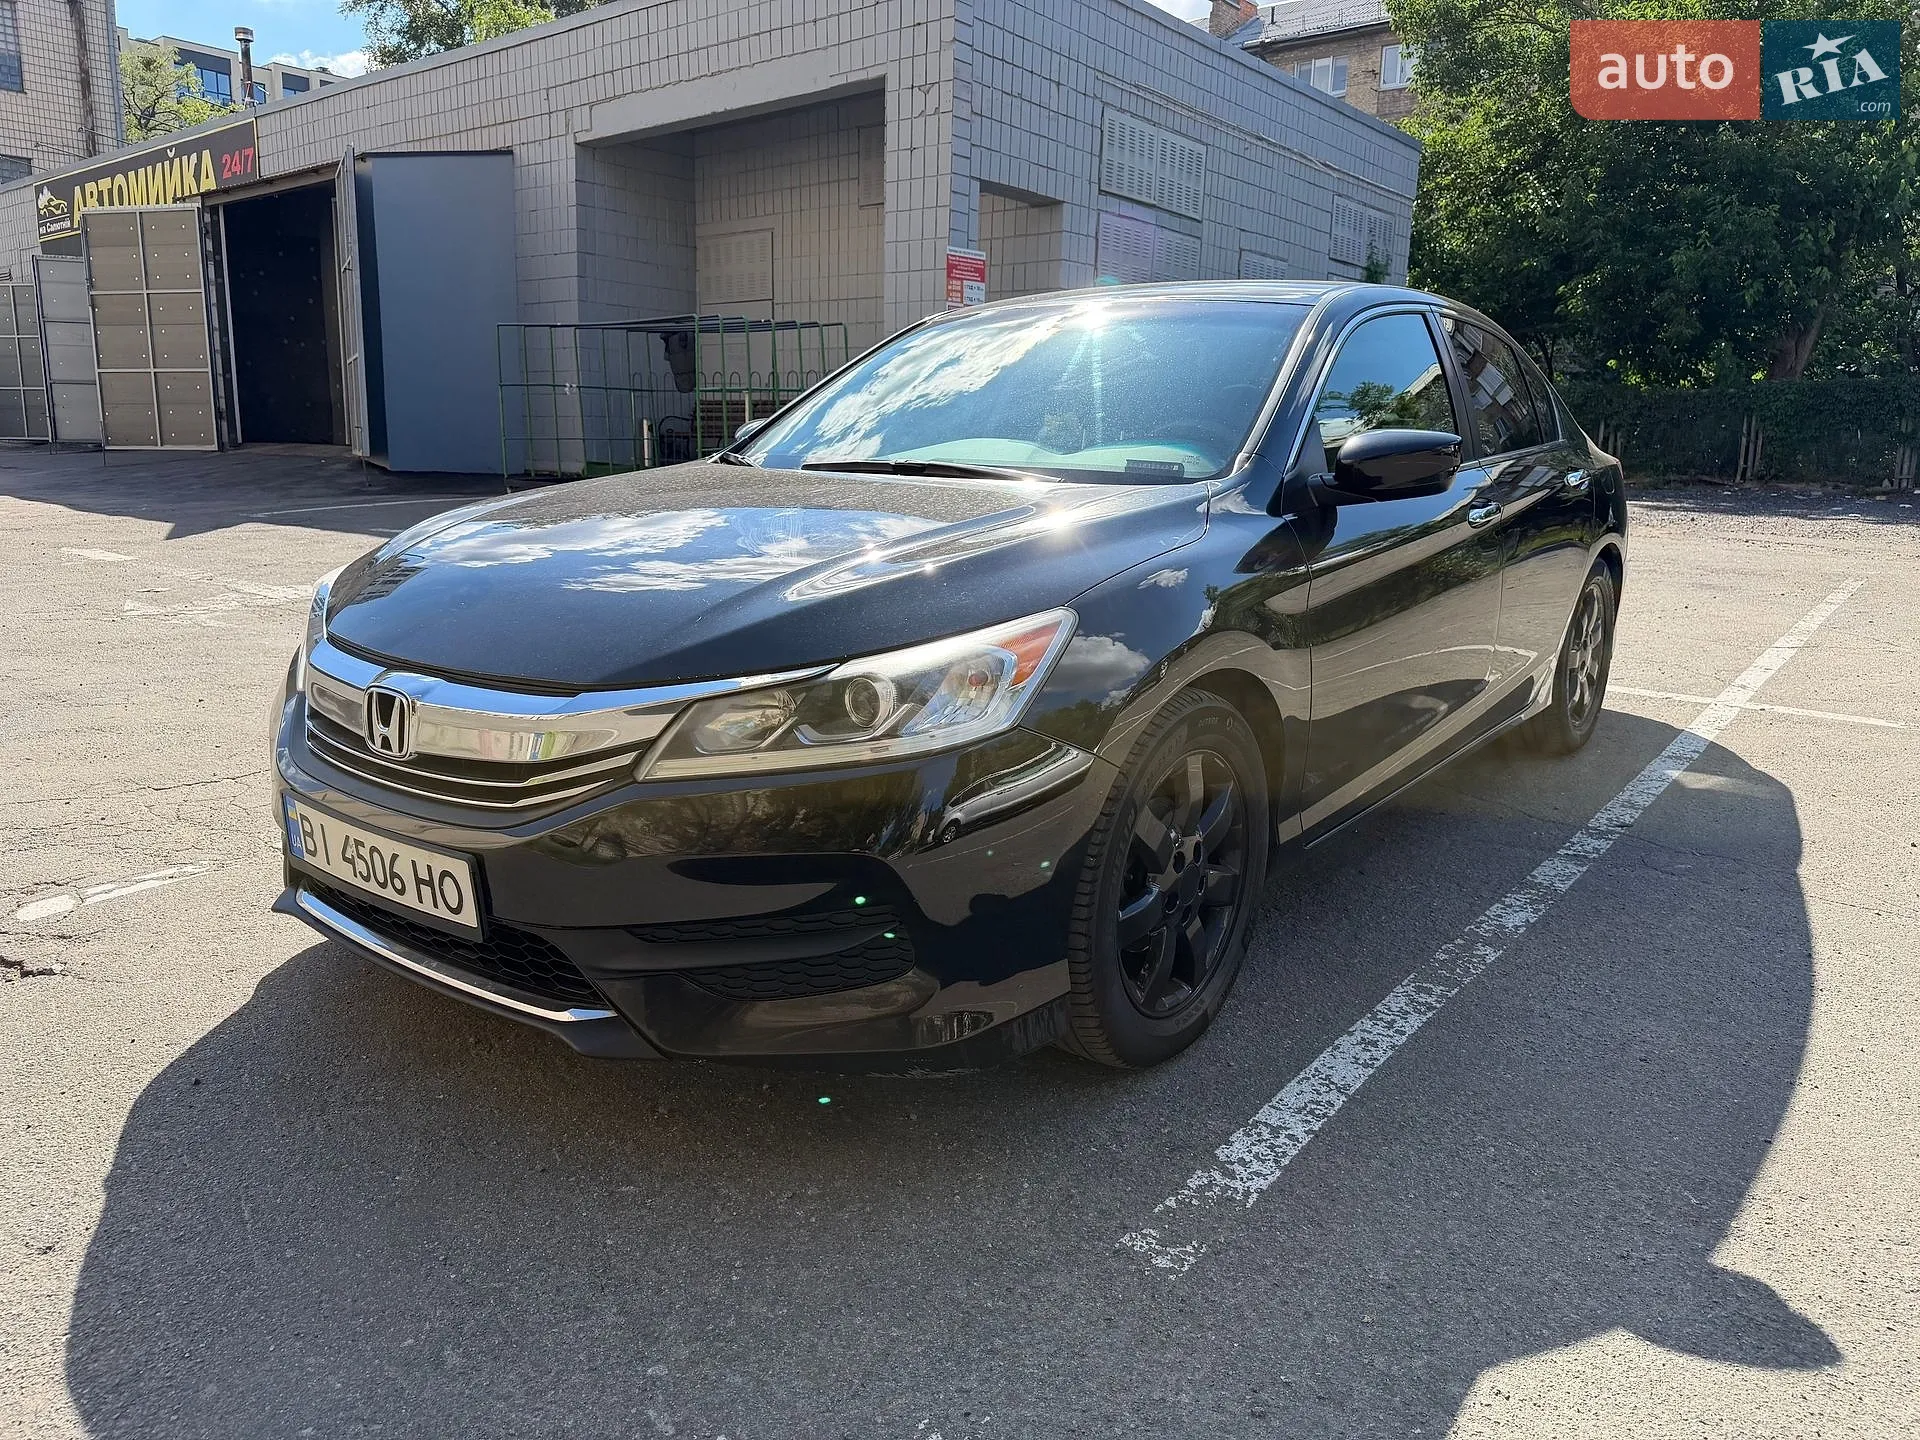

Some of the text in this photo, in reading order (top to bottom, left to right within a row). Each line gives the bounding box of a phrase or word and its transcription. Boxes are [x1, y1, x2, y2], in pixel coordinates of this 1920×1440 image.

[73, 147, 254, 229] АВТОМИЙКА 24/7
[291, 834, 303, 848] UA
[299, 812, 464, 916] BI 4506 HO
